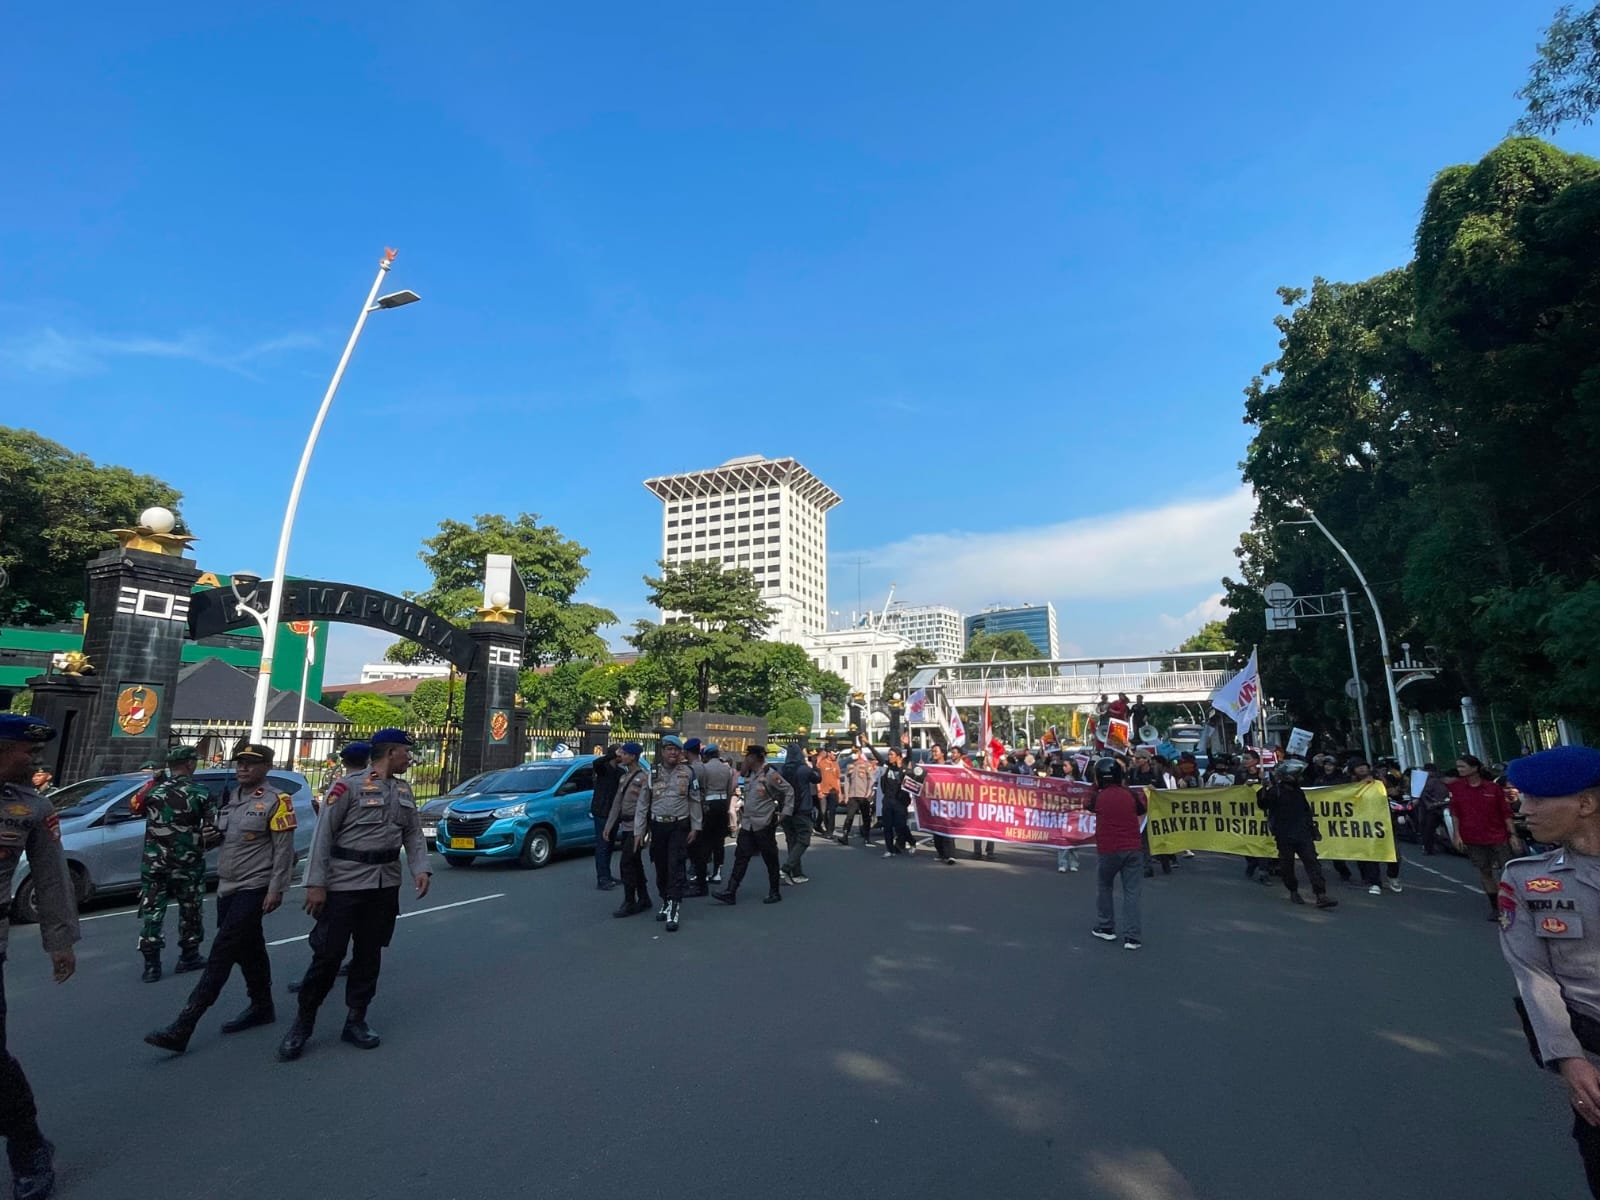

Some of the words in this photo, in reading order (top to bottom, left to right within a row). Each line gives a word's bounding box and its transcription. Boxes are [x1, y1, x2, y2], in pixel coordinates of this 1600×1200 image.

[925, 781, 975, 800] LAWAN
[980, 786, 1037, 807] PERANG
[931, 800, 974, 819] REBUT
[978, 804, 1019, 826] UPAH,
[1023, 807, 1072, 832] TANAH,
[1171, 801, 1222, 815] PERAN
[1229, 801, 1255, 817] TNI
[1151, 817, 1207, 836] RAKYAT
[1215, 817, 1274, 837] DISIRA
[1328, 820, 1386, 839] KERAS
